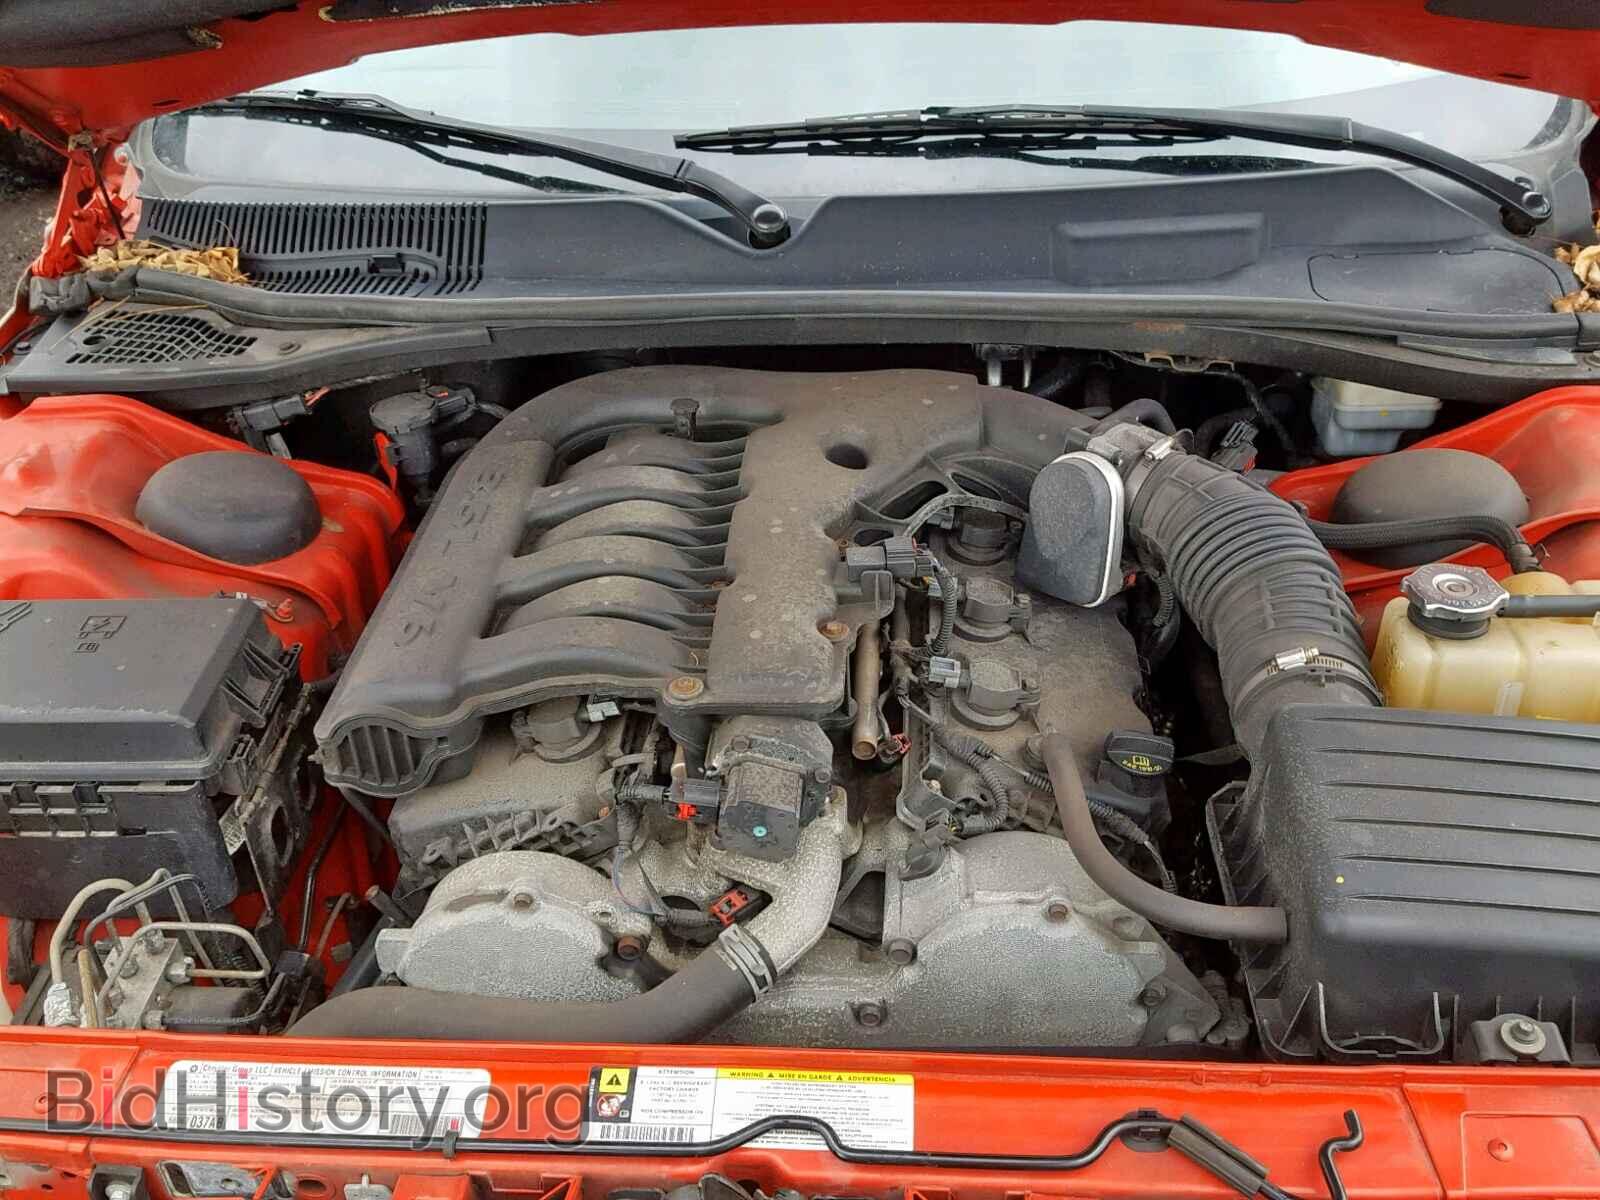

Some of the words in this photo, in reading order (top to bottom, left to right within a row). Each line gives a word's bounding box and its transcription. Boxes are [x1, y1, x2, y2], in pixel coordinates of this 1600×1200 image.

[255, 1065, 270, 1074] LLC
[337, 1068, 368, 1077] CONTROL
[370, 1069, 418, 1078] INFORMATION
[729, 1071, 764, 1079] WARNING
[847, 1075, 896, 1083] ADVERTENCIA
